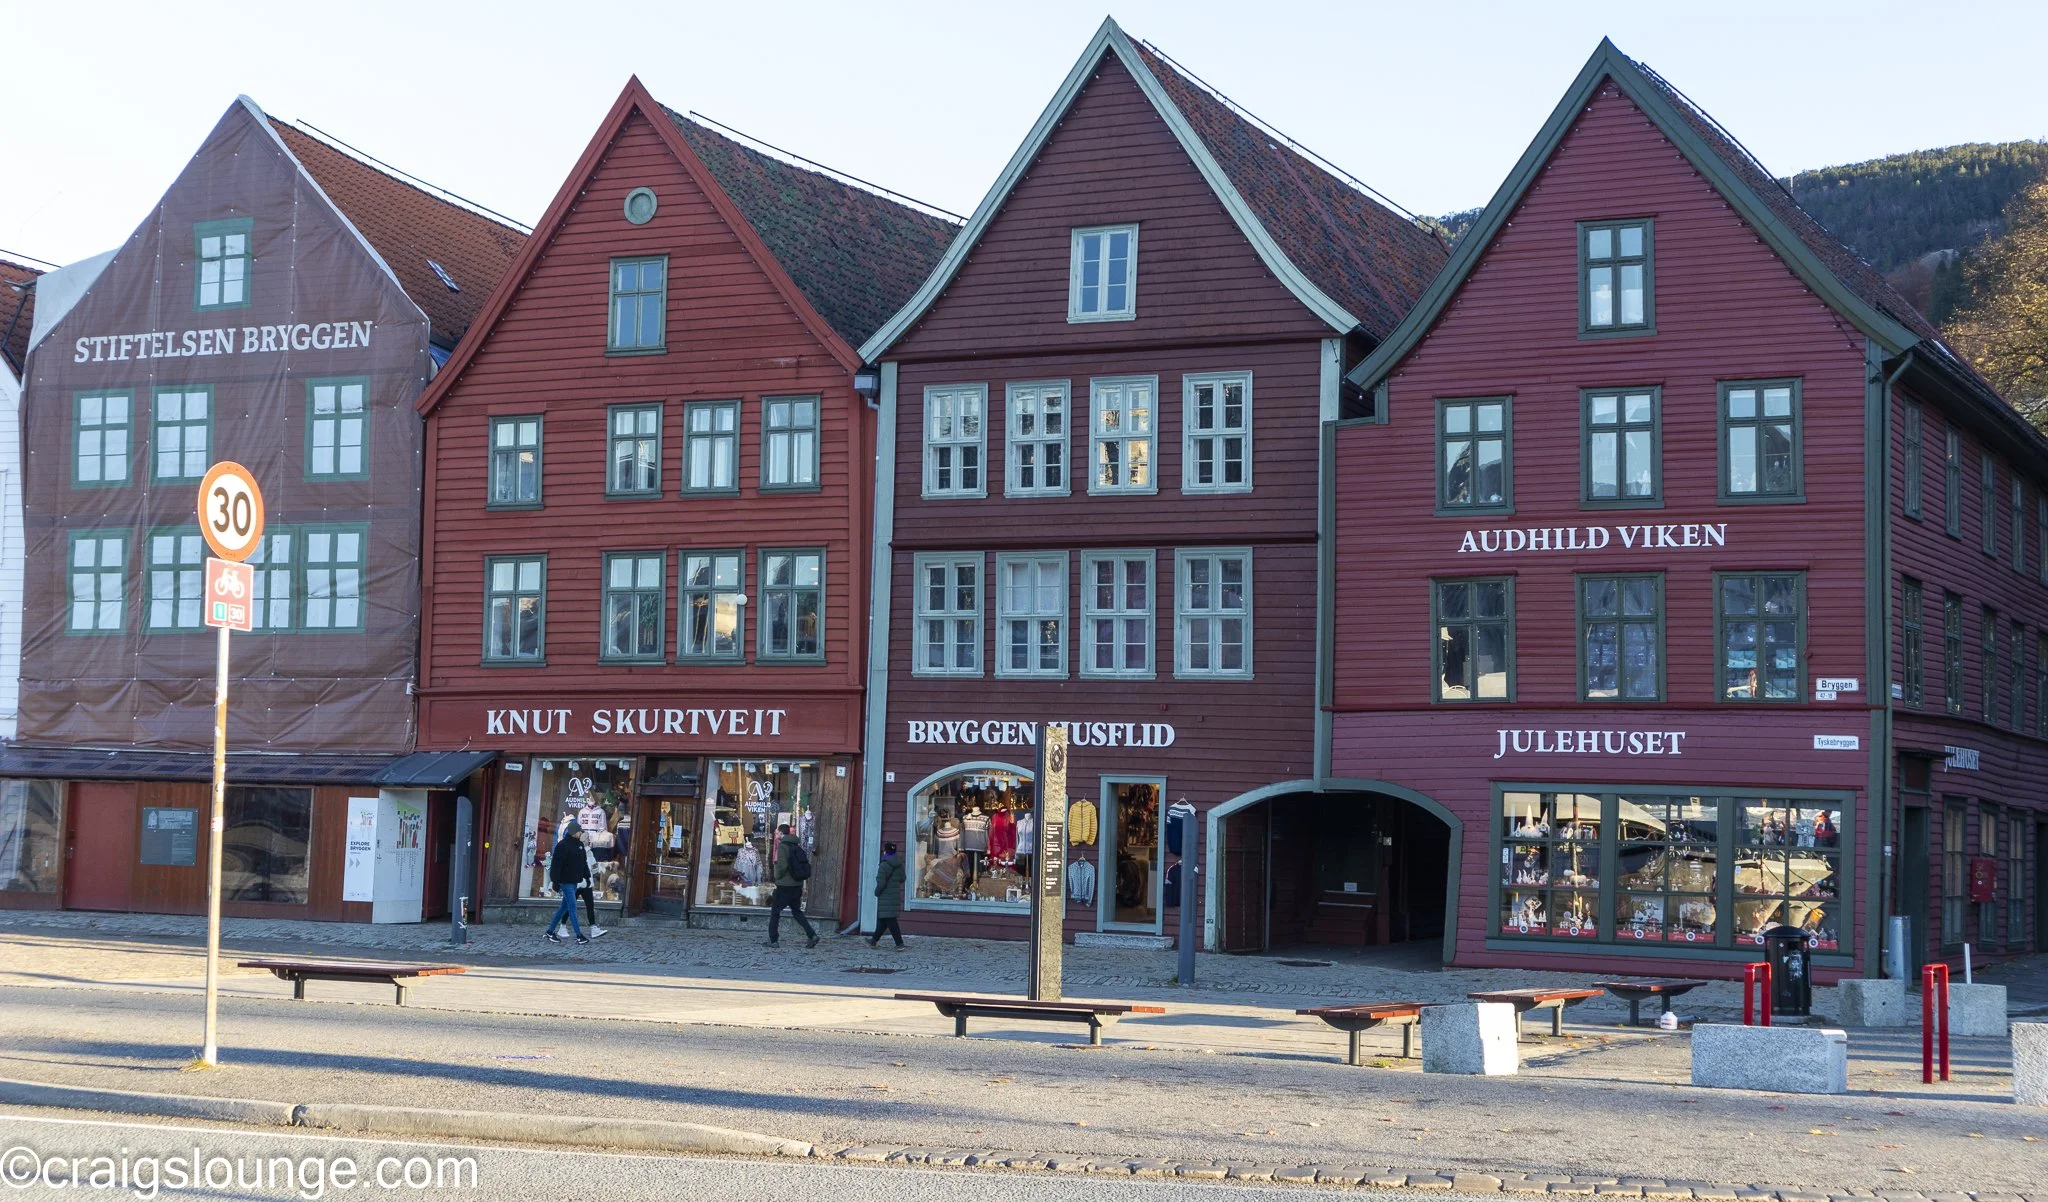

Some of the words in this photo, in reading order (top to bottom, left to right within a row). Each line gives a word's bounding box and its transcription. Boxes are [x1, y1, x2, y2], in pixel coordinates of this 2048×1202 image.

[74, 328, 235, 363] STIFTELSEN
[241, 320, 373, 353] BRYGGEN
[213, 487, 251, 536] 30
[1458, 526, 1610, 553] AUDHILD
[1615, 523, 1728, 549] VIKEN
[230, 606, 243, 621] 30
[1821, 680, 1853, 691] Bryggen
[486, 709, 573, 735] KNUT
[591, 708, 787, 736] SKURTVEIT
[907, 720, 1036, 746] BRYGGEN
[1048, 721, 1175, 747] USFLID
[1493, 729, 1687, 759] JULEHUSET
[1817, 737, 1857, 748] Tyskebryggen
[1944, 745, 1980, 773] JULEHUSET
